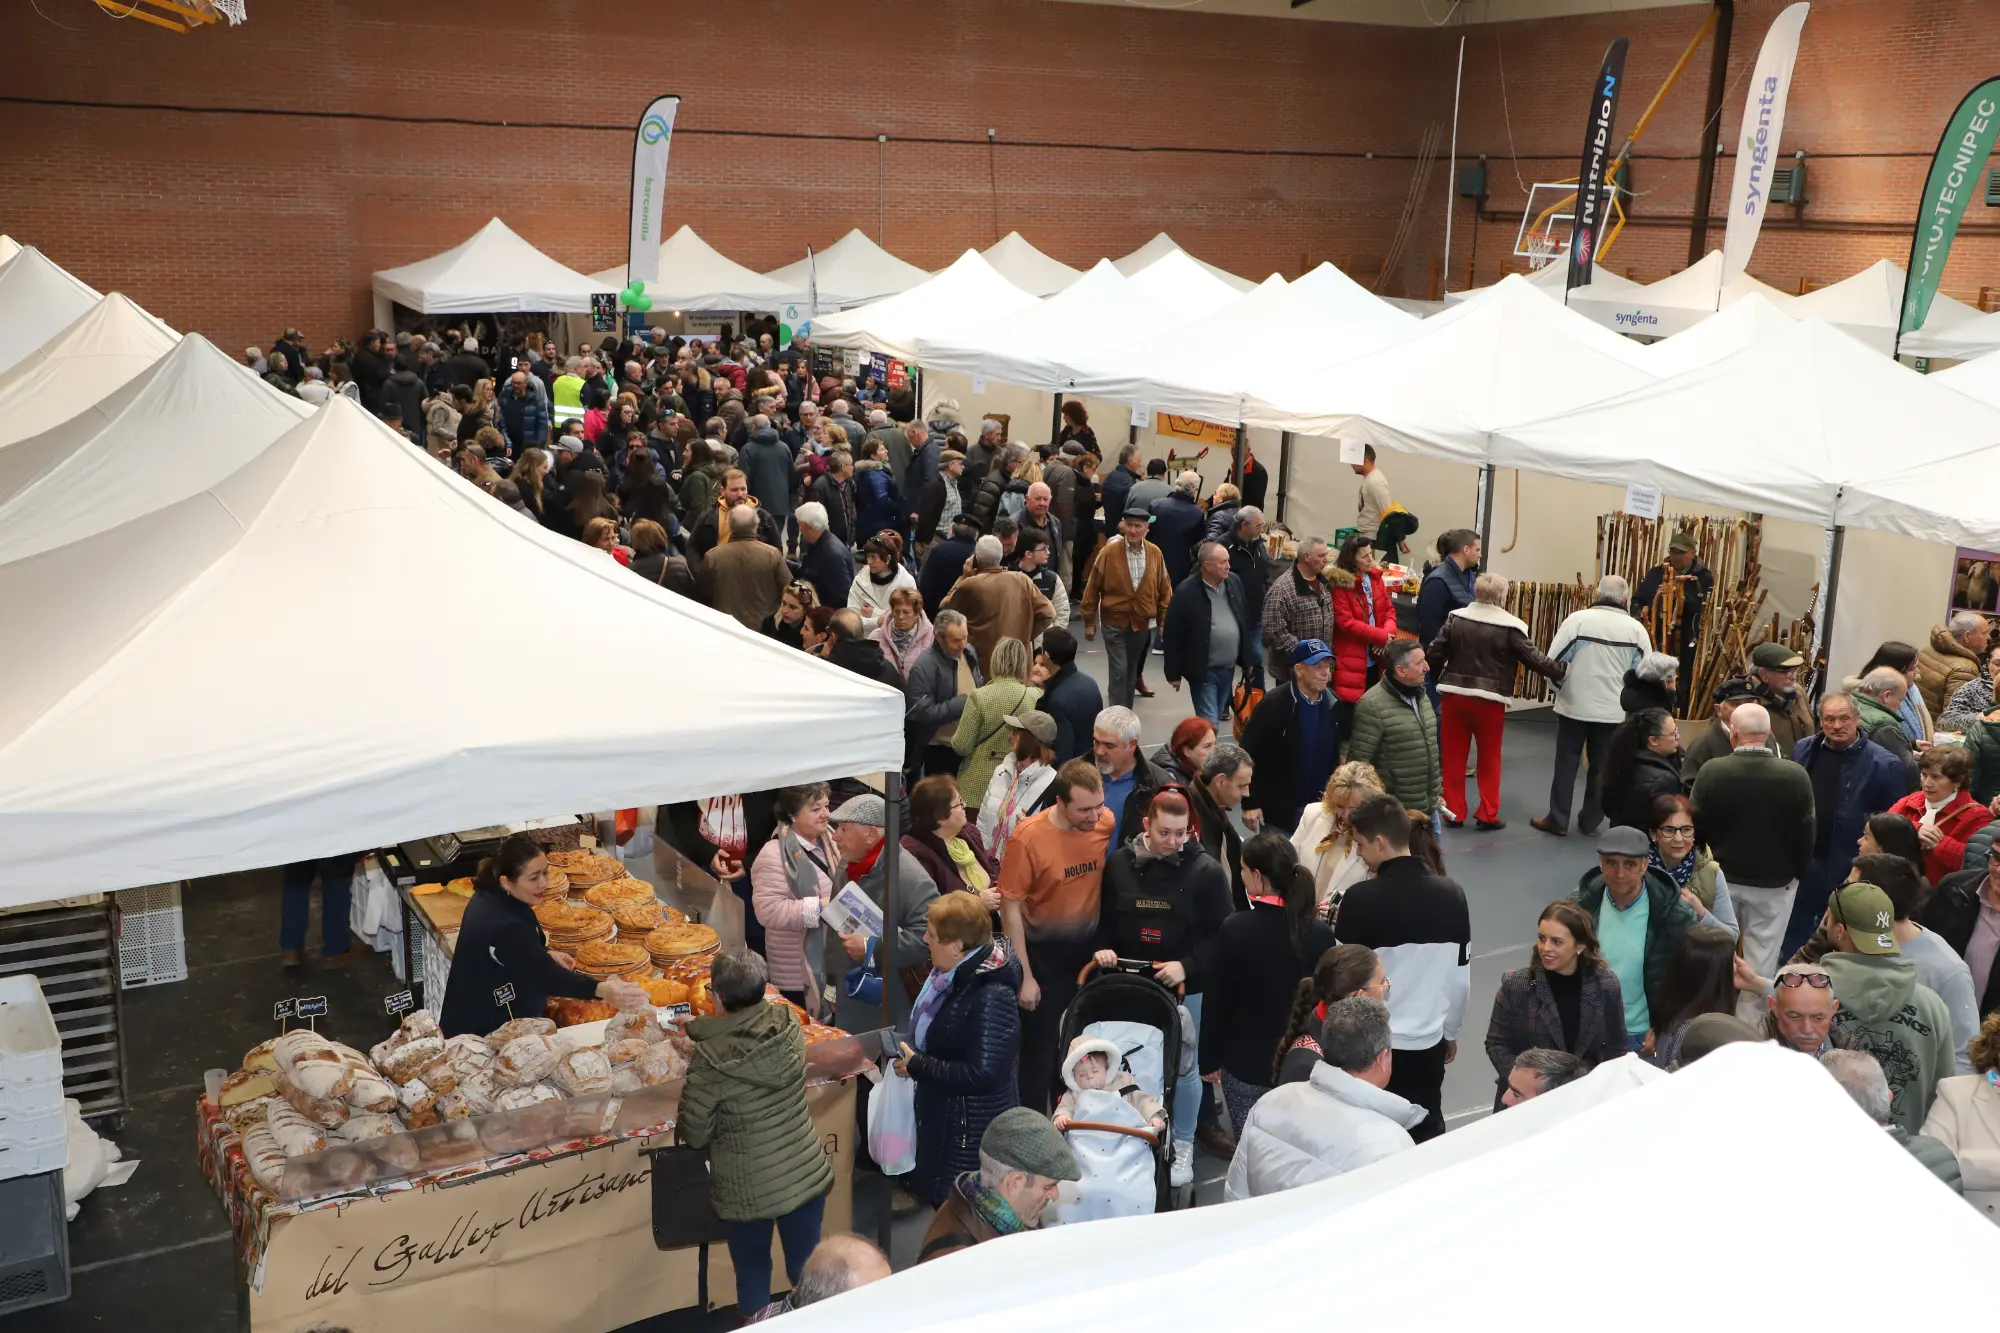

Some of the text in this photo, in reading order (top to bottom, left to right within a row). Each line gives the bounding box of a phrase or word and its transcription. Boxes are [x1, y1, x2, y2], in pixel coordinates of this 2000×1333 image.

[1745, 76, 1778, 216] syngenta
[1615, 312, 1658, 326] syngenta
[1064, 860, 1098, 878] HOLIDAY
[306, 1247, 364, 1300] del
